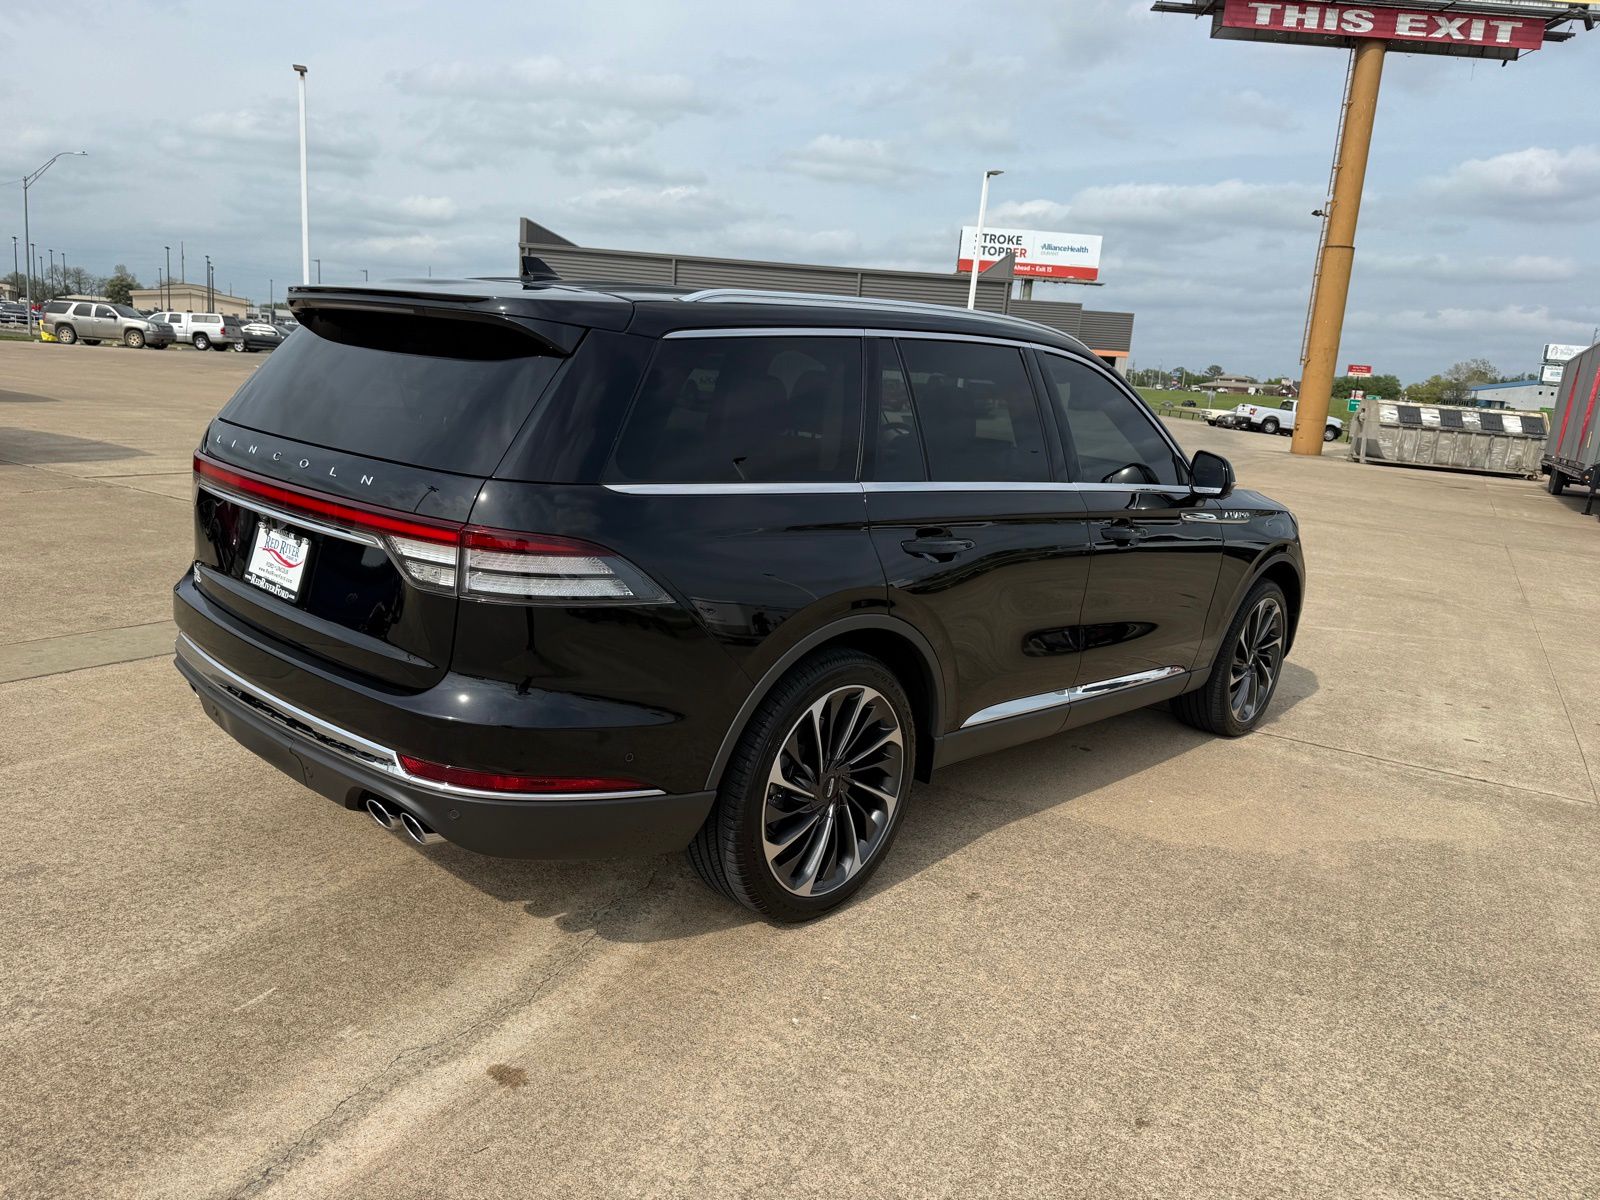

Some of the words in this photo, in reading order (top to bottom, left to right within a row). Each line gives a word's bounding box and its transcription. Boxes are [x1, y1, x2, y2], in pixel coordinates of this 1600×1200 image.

[1248, 2, 1375, 33] THIS
[1395, 13, 1523, 43] EXIT
[974, 245, 1027, 258] TOPPER
[1041, 243, 1089, 253] AllianceHealth
[216, 435, 374, 486] LINCOLN
[265, 535, 280, 549] RED
[279, 540, 300, 558] RIVER
